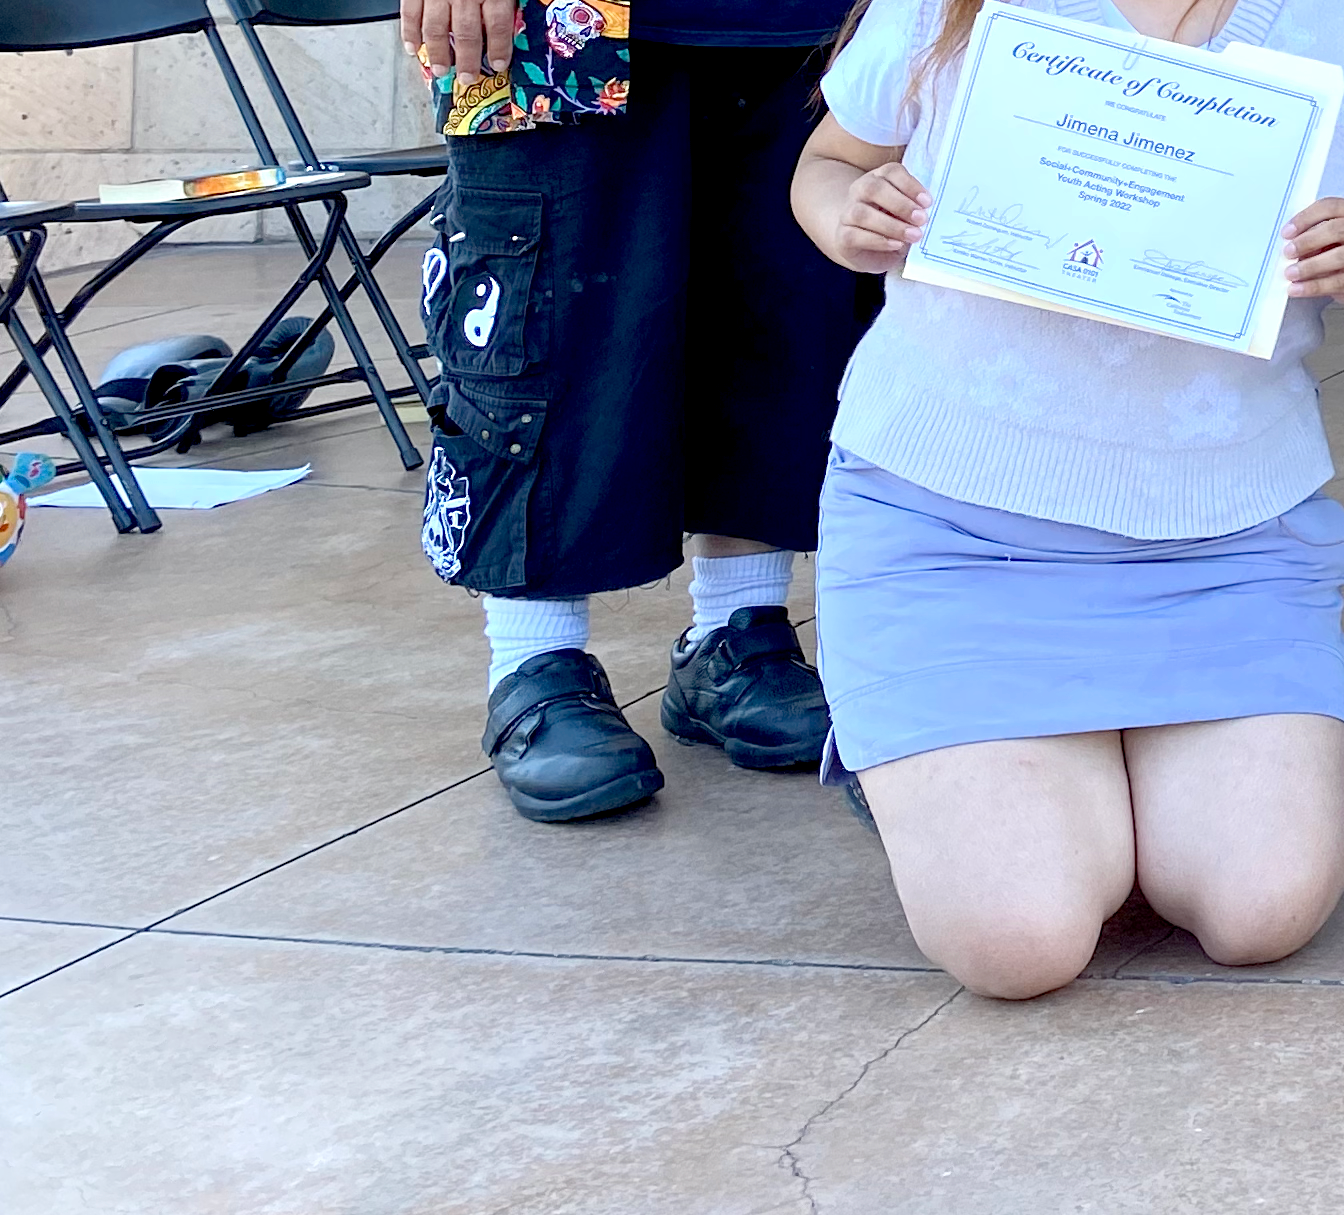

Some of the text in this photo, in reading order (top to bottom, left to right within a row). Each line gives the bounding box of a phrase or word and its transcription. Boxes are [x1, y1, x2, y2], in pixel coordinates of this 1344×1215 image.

[1012, 41, 1276, 128] Certificate of Completion
[1056, 113, 1196, 163] Jimena Jimenez
[1057, 172, 1161, 208] Youth Acting Workshop
[1077, 190, 1133, 212] Spring 2022
